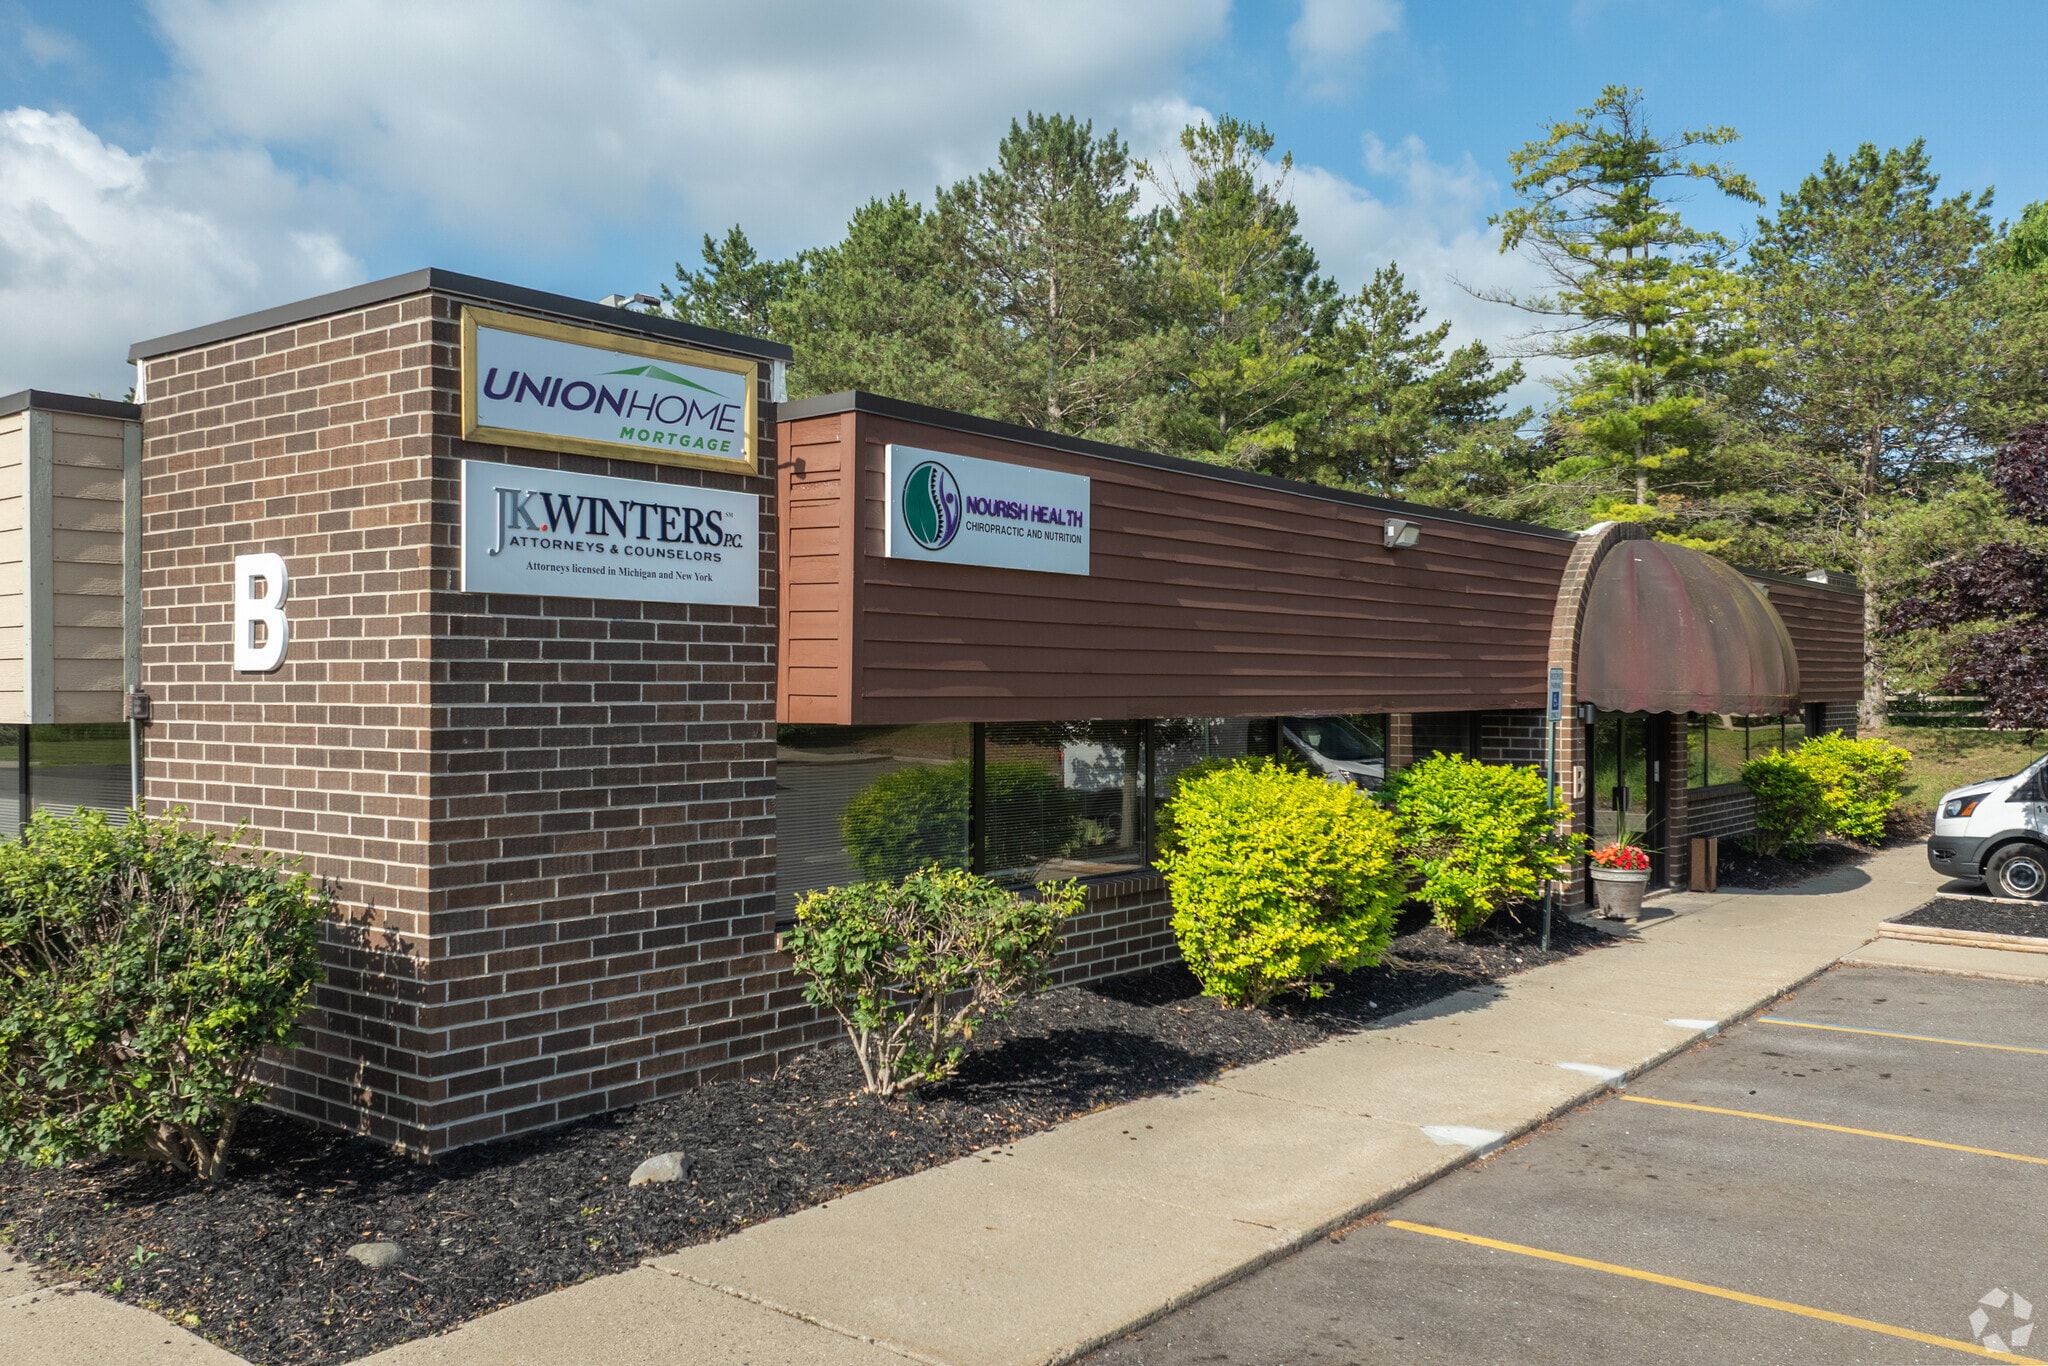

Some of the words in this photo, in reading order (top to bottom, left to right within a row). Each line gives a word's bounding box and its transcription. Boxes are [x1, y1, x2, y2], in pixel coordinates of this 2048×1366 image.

[620, 426, 732, 452] MORTGAGE
[966, 496, 1028, 521] NOURISH
[1031, 505, 1083, 528] HEALTH
[966, 521, 1024, 538] CHIROPRACTIC
[1027, 528, 1042, 539] AND
[1044, 532, 1082, 544] NUTRITION
[509, 536, 605, 554] ATTORNEYS
[610, 544, 619, 554] &
[624, 545, 722, 562] COUNSELORS
[526, 561, 570, 575] Attorneys
[571, 563, 606, 575] licensed
[608, 566, 616, 575] in
[619, 566, 656, 579] Michigan
[659, 570, 674, 579] and
[676, 571, 692, 580] New
[694, 572, 713, 582] York
[234, 552, 289, 672] B
[1573, 766, 1585, 799] B
